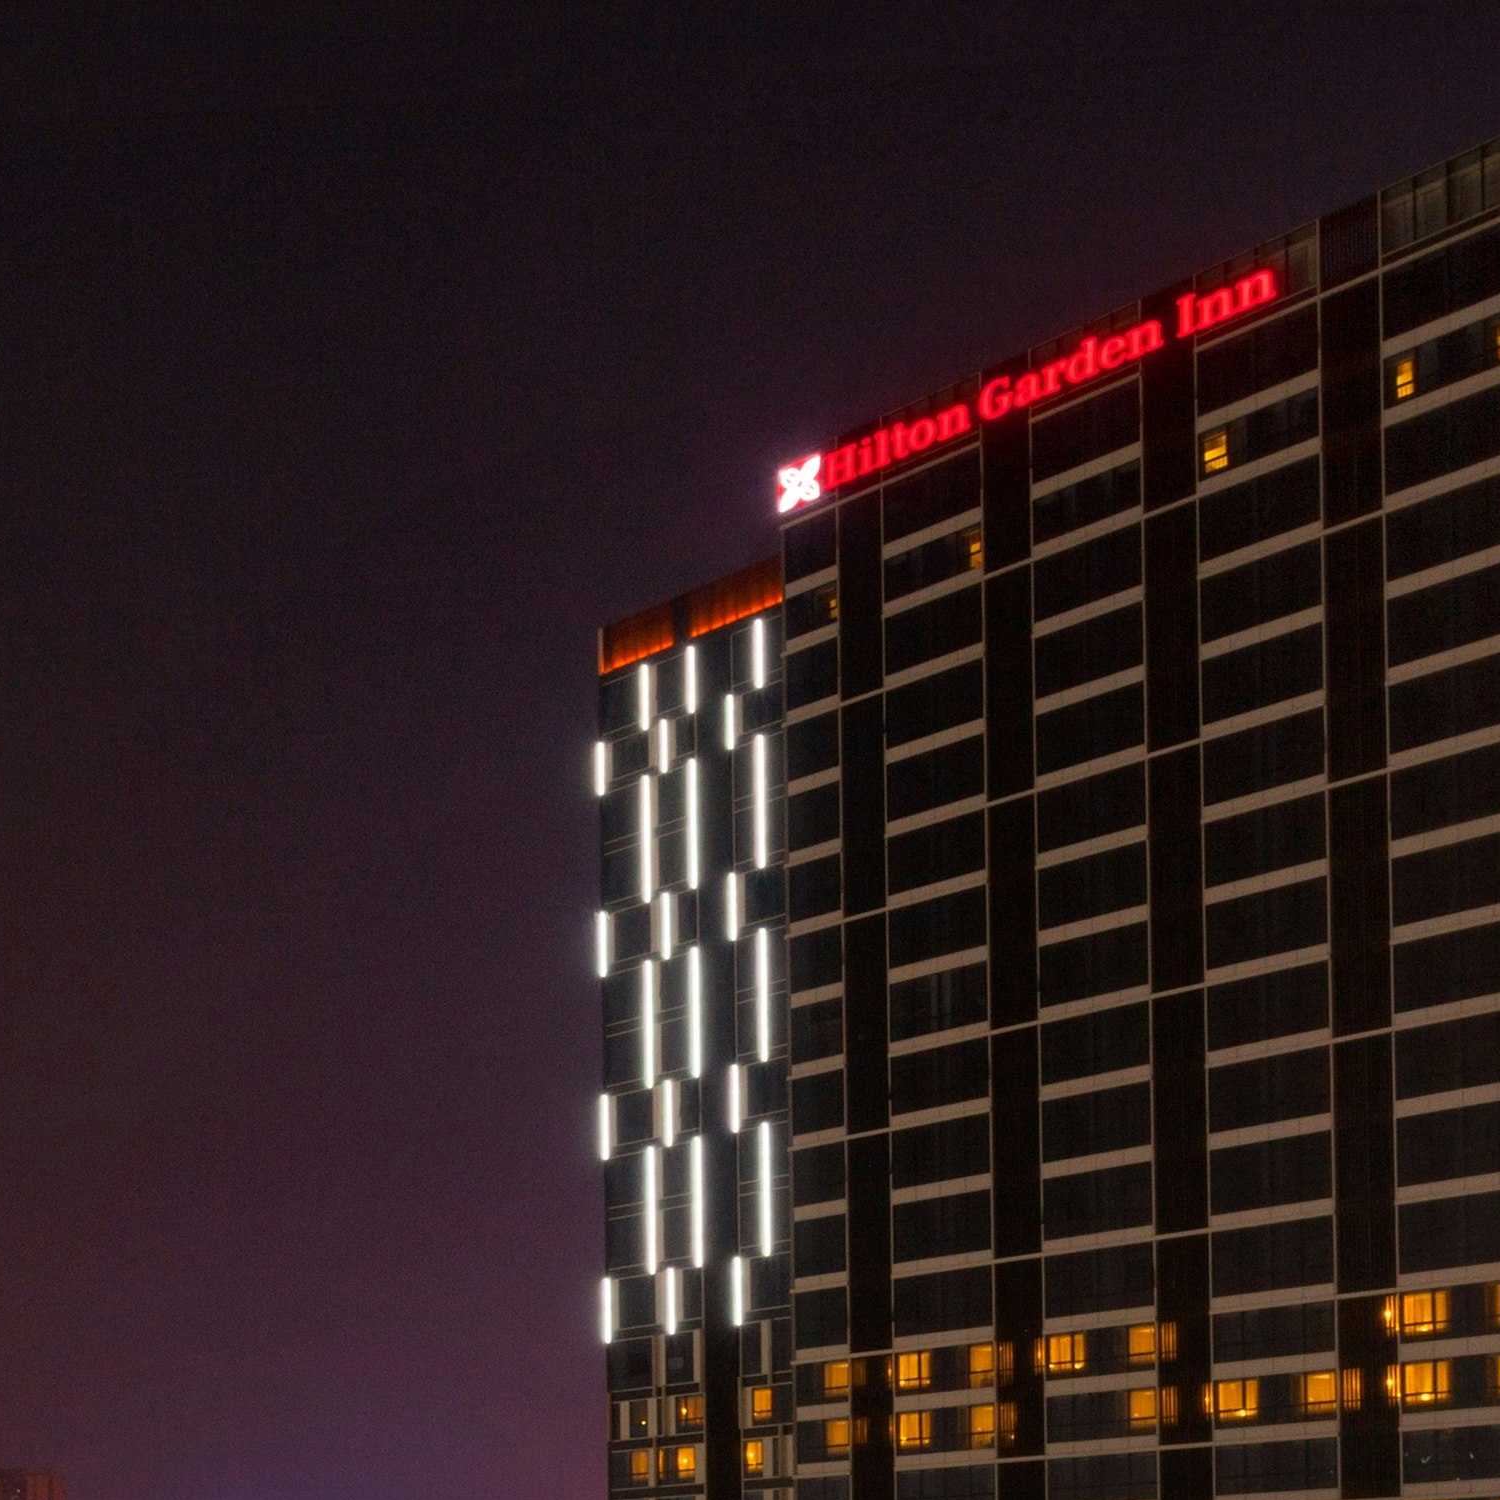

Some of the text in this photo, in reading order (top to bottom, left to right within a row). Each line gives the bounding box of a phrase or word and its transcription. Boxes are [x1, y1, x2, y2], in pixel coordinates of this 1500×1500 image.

[822, 269, 1277, 493] Hilton Garden Inn
